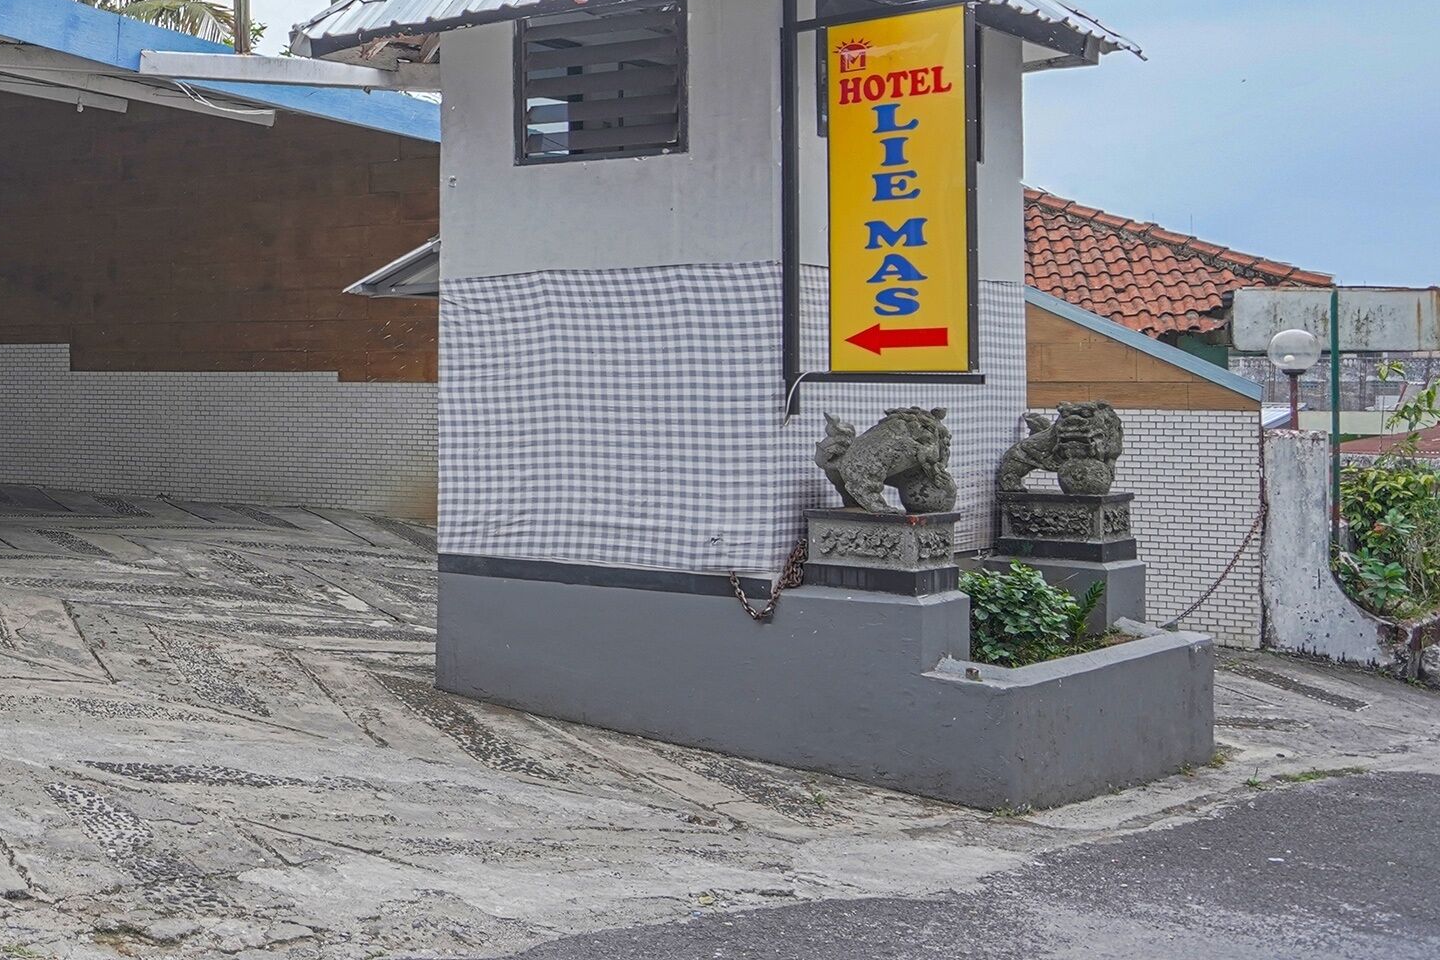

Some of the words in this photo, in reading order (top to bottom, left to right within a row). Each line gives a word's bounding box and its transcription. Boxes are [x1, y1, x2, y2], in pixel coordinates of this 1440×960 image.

[839, 66, 952, 105] HOTEL
[871, 103, 921, 202] LIE
[864, 217, 928, 317] MAS
